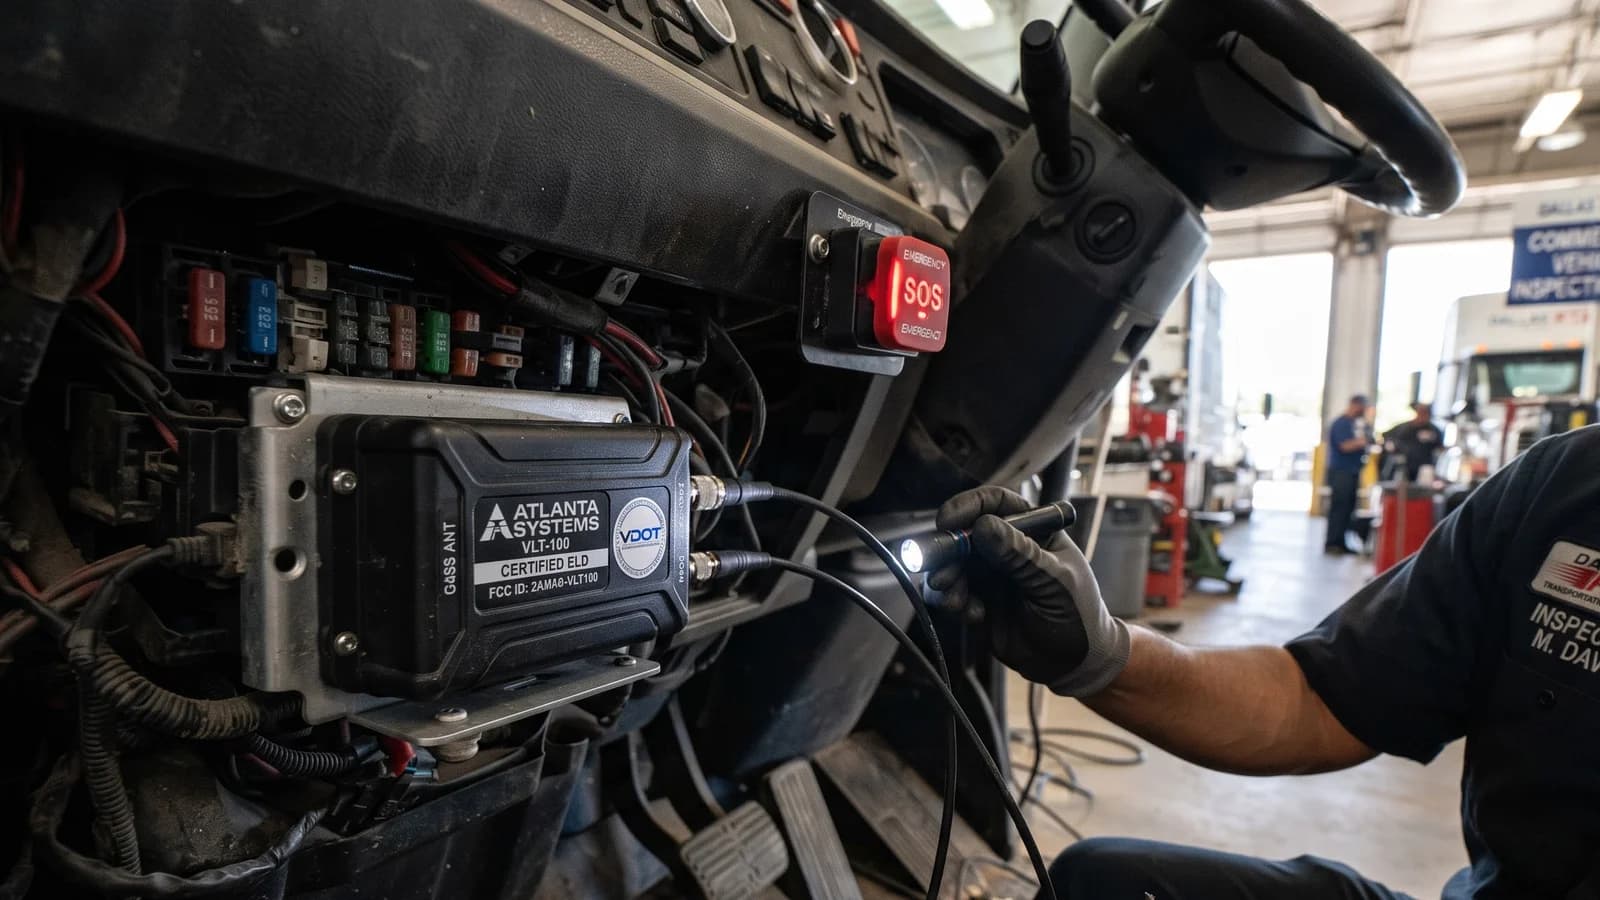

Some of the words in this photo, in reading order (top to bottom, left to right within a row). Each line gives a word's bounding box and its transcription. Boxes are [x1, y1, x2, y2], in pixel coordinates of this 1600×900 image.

[903, 276, 943, 312] SOS
[513, 499, 600, 521] ATLANTA
[442, 521, 456, 553] ANT
[513, 515, 600, 538] SYSTEMS
[619, 527, 662, 544] VDOT
[521, 536, 570, 554] VLT-100
[500, 557, 564, 578] CERTIFIED
[567, 554, 589, 569] ELD
[488, 584, 512, 599] FCC
[514, 583, 529, 595] ID:
[1529, 601, 1600, 646] INSPEC
[1530, 628, 1554, 654] M.
